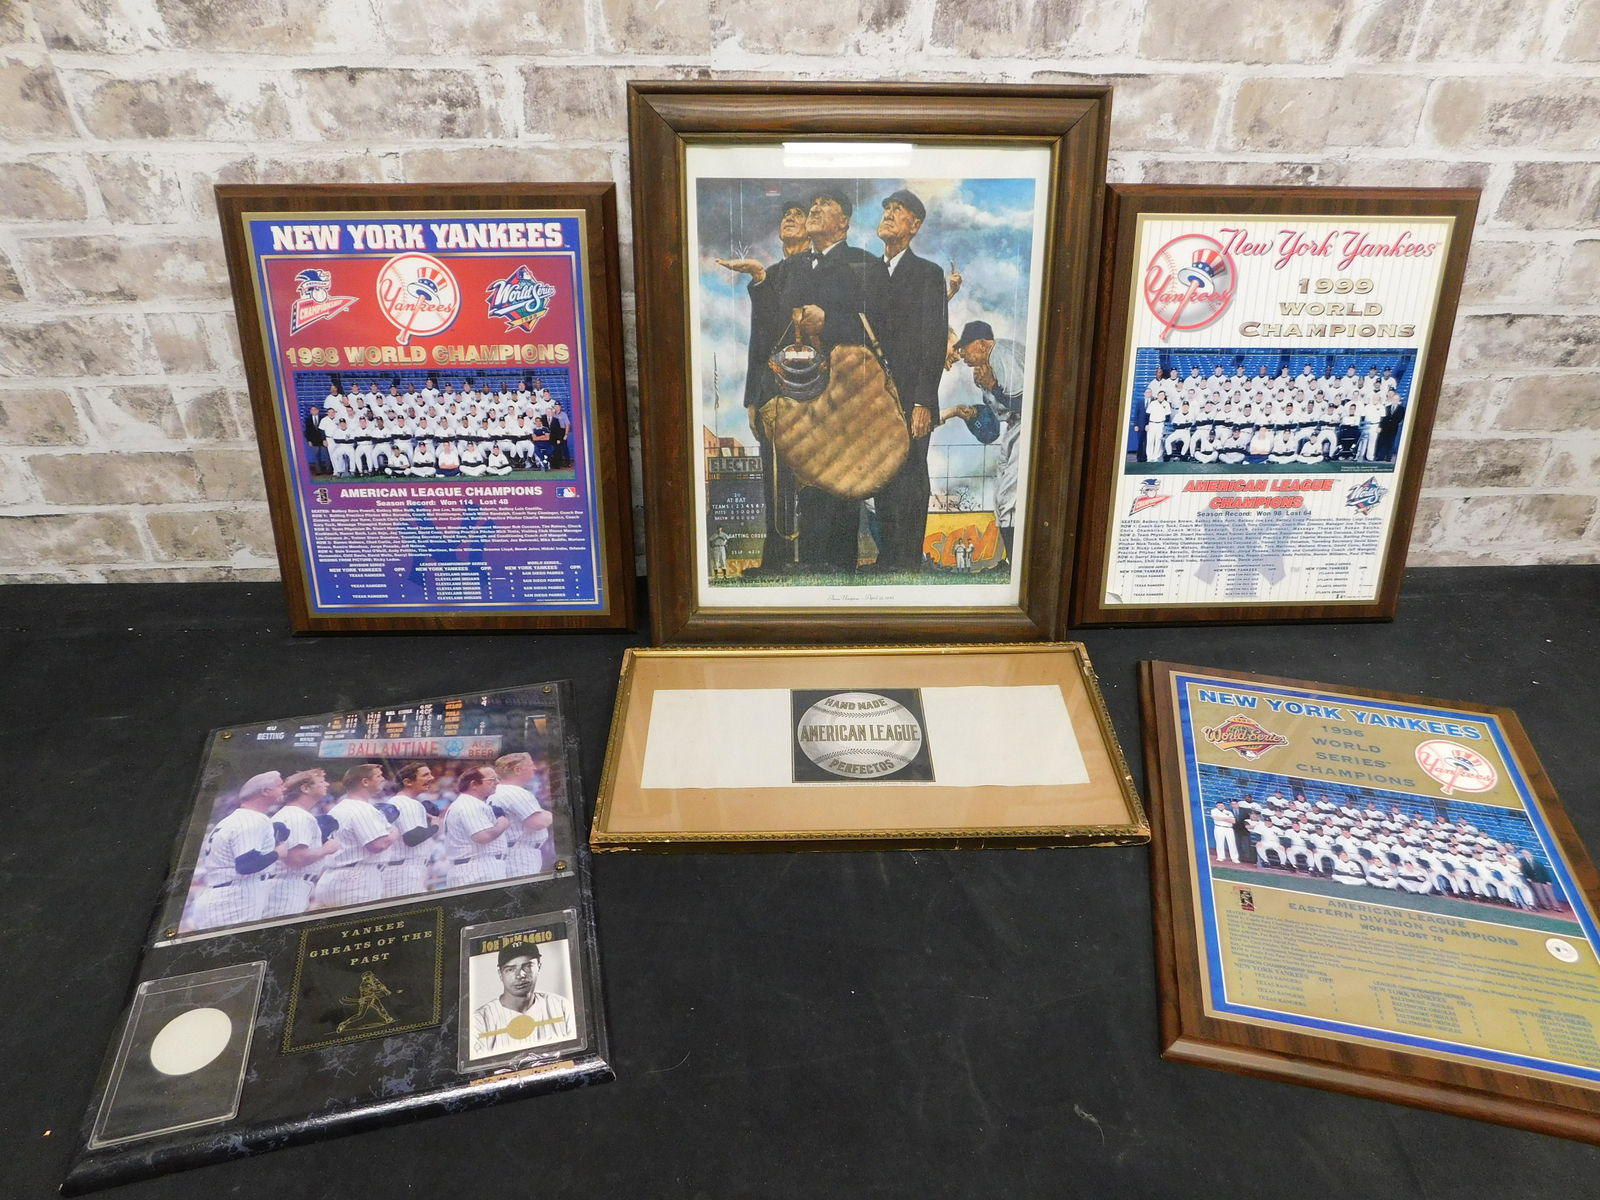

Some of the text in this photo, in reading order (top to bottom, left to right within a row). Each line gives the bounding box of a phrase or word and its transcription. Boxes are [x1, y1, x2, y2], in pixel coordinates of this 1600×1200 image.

[270, 222, 563, 250] NEW YORK YANKEES
[1220, 228, 1437, 272] New York Yankees
[492, 281, 533, 306] World
[1145, 265, 1231, 307] Yankees
[1298, 278, 1375, 295] 1999
[378, 278, 455, 314] Yankees
[1279, 301, 1383, 317] WORLD
[286, 343, 570, 367] 1998 WORLD CHAMPIONS
[340, 486, 543, 498] AMERICAN LEAGUE CHAMPIONS
[1181, 478, 1335, 492] AMERICAN LEAGUE
[406, 499, 436, 507] Record:
[1208, 496, 1304, 509] CHAMPIONS
[824, 698, 887, 710] HAND MADE
[1198, 689, 1482, 740] NEW YORK YANKEES
[800, 724, 920, 741] AMERICAN LEAGUE
[1321, 725, 1365, 738] 1996
[347, 741, 439, 757] BALLANTINE
[1311, 737, 1382, 754] WORLD
[828, 759, 895, 775] PERFECTOS
[1315, 752, 1383, 768] SERIES
[1296, 763, 1416, 788] CHAMPIONS
[1327, 900, 1467, 929] AMERICAN LEAGUE
[340, 920, 405, 938] YANKEE
[1288, 902, 1353, 920] EASTERN
[1359, 911, 1424, 933] DIVISION
[1428, 925, 1520, 947] CHAMPIONS
[1360, 923, 1384, 934] WON
[1403, 928, 1429, 941] LOST
[309, 930, 433, 958] GREATS OF THE
[482, 940, 499, 952] JOE
[350, 952, 390, 966] PAST
